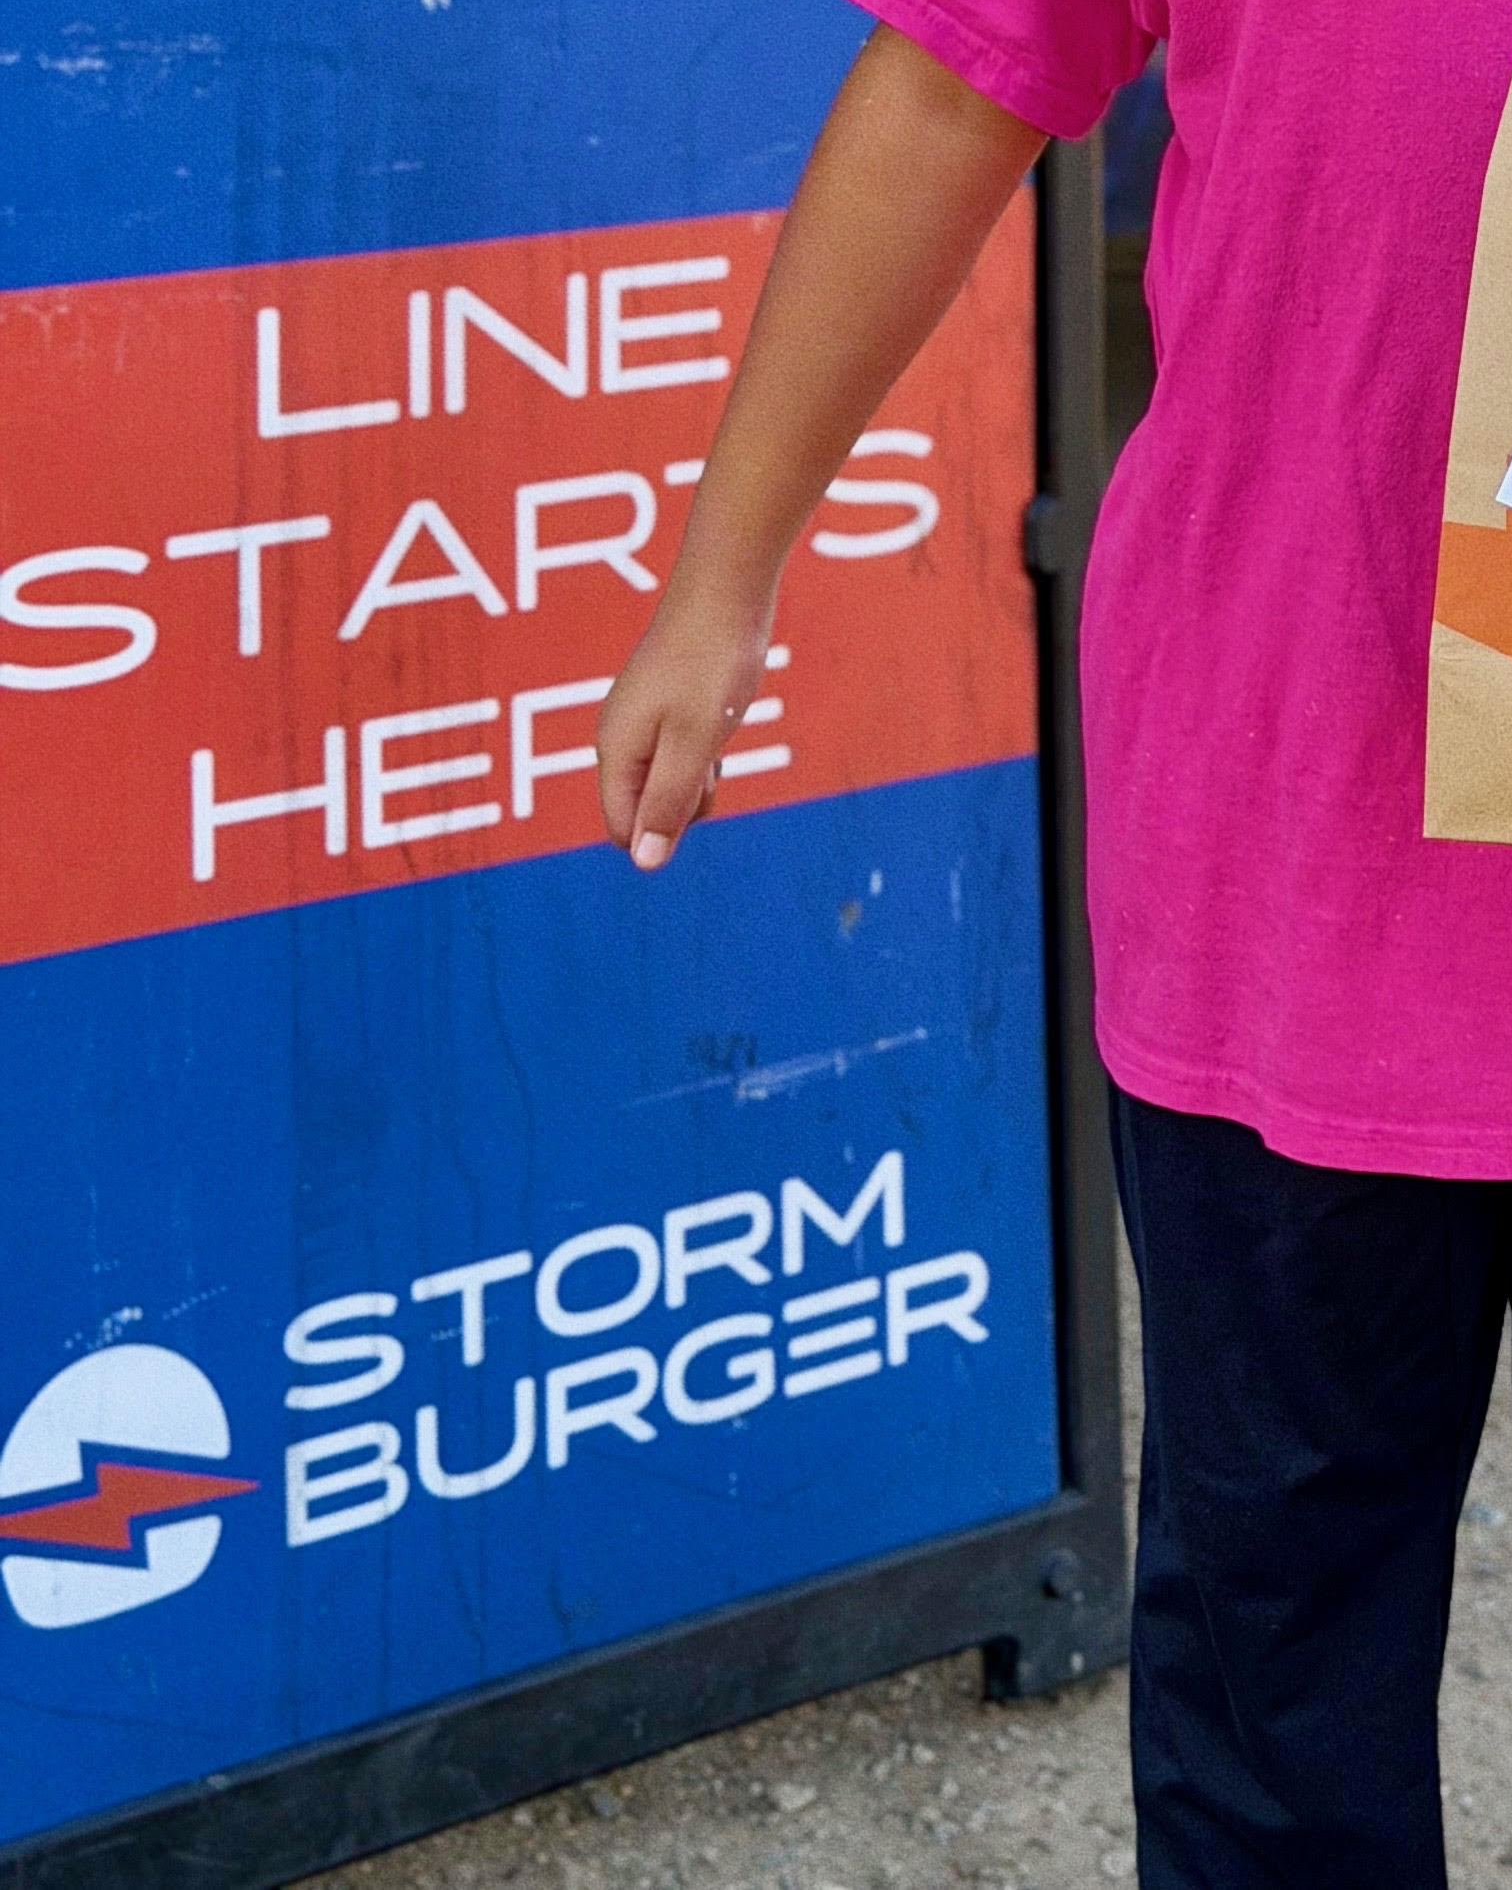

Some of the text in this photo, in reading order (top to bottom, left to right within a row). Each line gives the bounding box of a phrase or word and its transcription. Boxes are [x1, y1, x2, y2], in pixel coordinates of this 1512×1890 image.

[256, 256, 731, 438] LINE
[0, 429, 940, 691] STARS
[282, 1149, 905, 1411] STORM
[284, 1250, 991, 1548] BURGER
